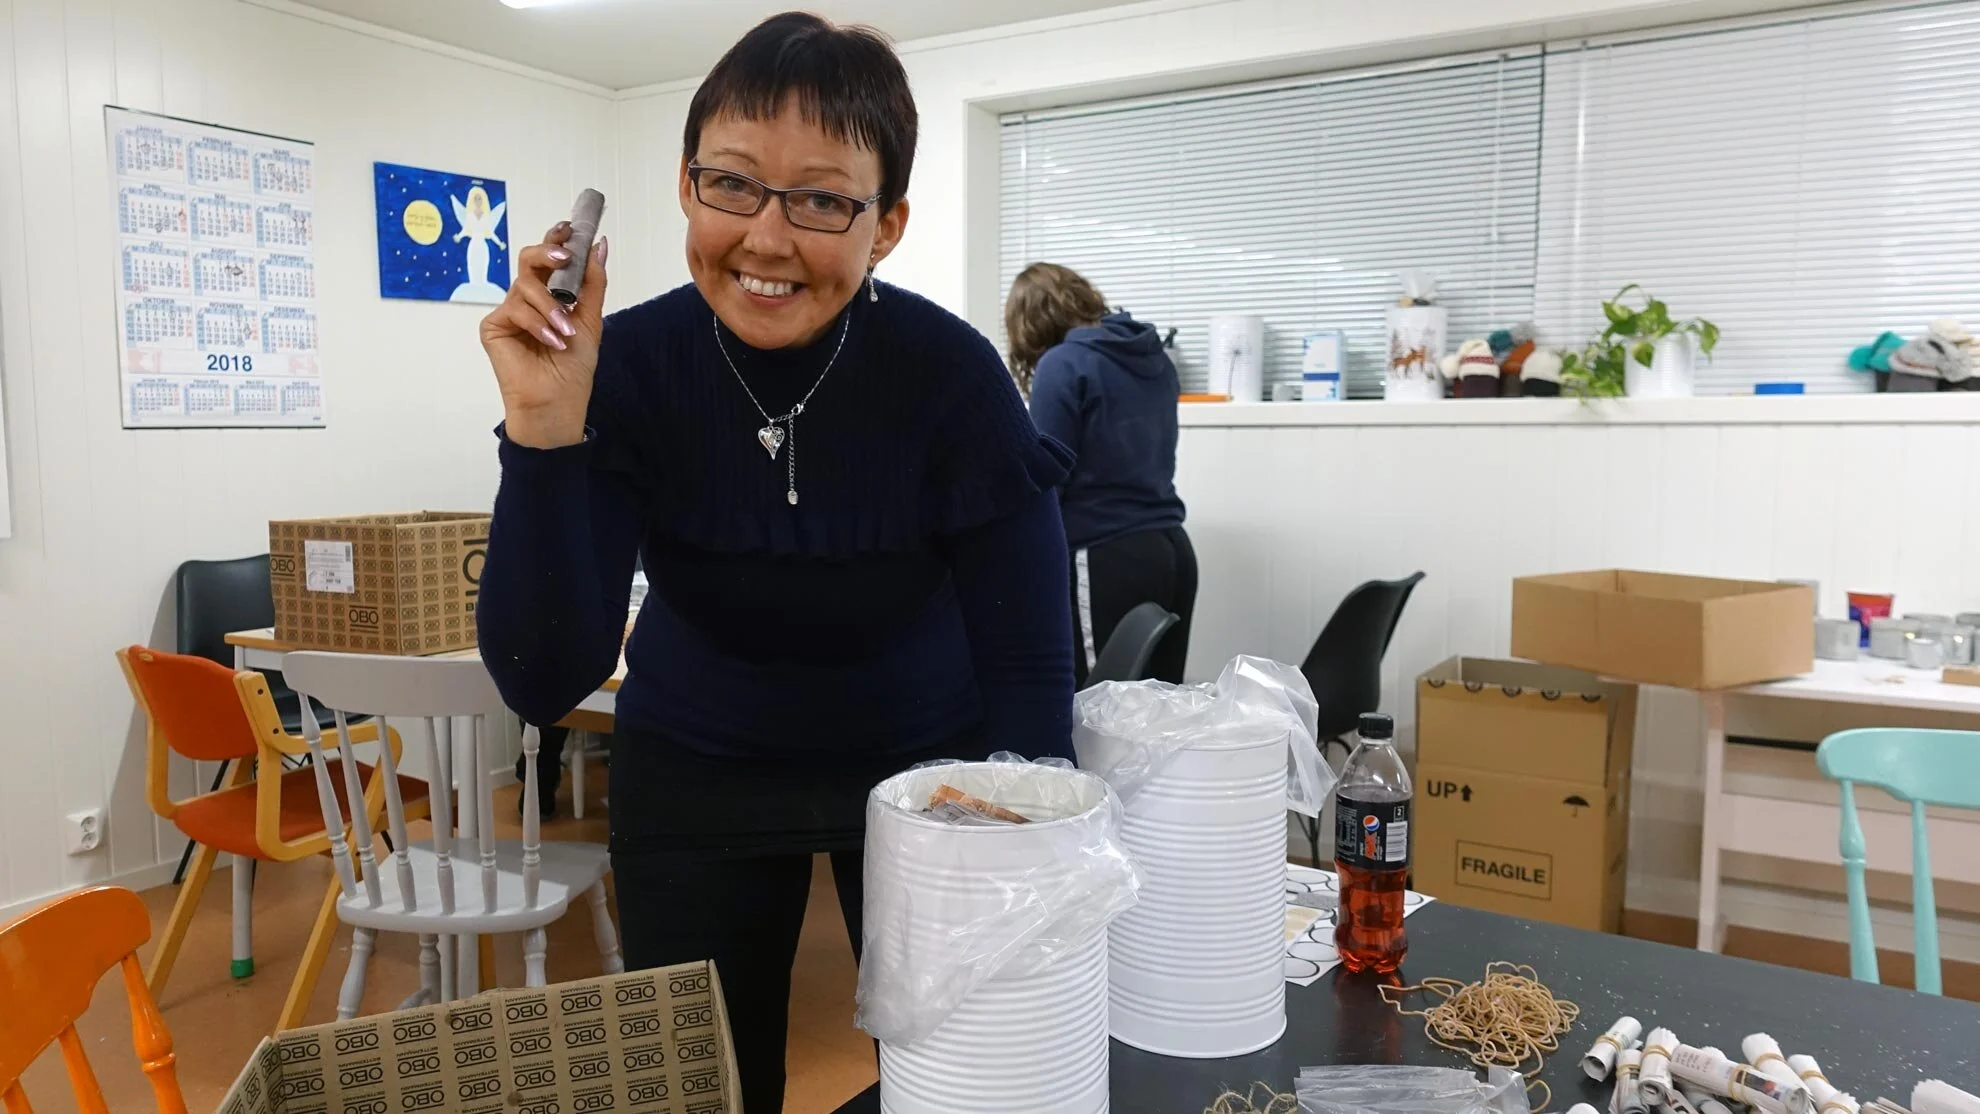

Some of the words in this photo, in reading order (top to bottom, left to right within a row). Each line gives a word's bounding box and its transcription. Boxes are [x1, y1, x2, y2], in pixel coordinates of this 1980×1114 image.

[207, 354, 252, 372] 2018
[270, 558, 295, 573] OBO
[349, 609, 379, 625] OBO
[1427, 779, 1457, 799] UP
[1461, 856, 1546, 885] FRAGILE
[670, 976, 709, 993] OBO
[616, 985, 656, 1002] OBO
[561, 994, 602, 1011] OBO
[506, 1003, 547, 1020] OBO
[674, 1009, 712, 1027] OBO
[450, 1013, 492, 1030] OBO
[620, 1018, 660, 1036] OBO
[394, 1023, 436, 1040] OBO
[565, 1027, 606, 1044] OBO
[335, 1033, 379, 1051] OBO
[510, 1036, 551, 1054] OBO
[455, 1046, 497, 1064] OBO
[624, 1051, 664, 1068] OBO
[398, 1056, 440, 1074] OBO
[570, 1061, 610, 1078] OBO
[339, 1067, 383, 1085] OBO
[515, 1070, 556, 1087] OBO
[459, 1079, 501, 1097] OBO
[628, 1084, 668, 1101] OBO
[402, 1090, 444, 1108] OBO
[574, 1093, 614, 1111] OBO
